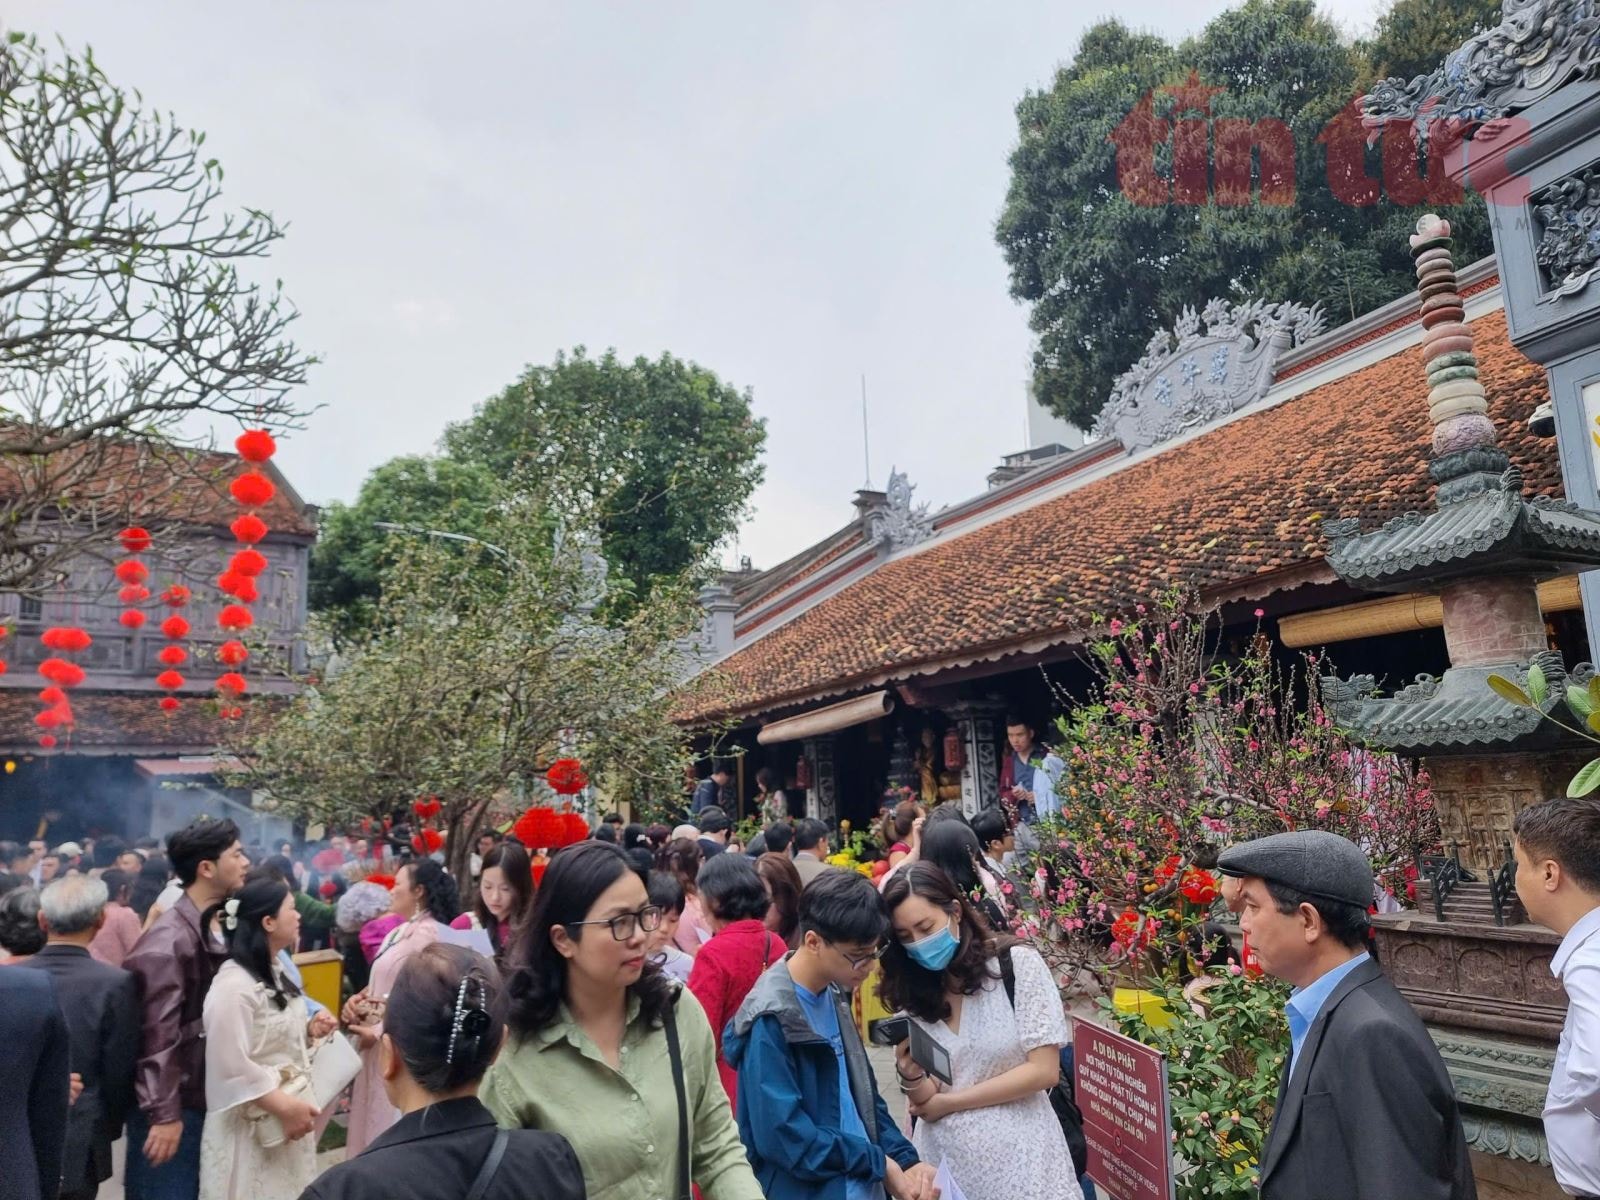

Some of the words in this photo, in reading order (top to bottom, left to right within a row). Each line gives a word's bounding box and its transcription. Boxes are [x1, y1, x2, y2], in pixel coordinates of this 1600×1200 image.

[1093, 1040, 1098, 1053] A
[1117, 1053, 1136, 1072] PHẬT
[1089, 1071, 1108, 1088] KHÁCH
[1133, 1094, 1150, 1112] HOAN
[1113, 1066, 1124, 1081] TÔN
[1124, 1073, 1147, 1094] NGHIÊM
[1080, 1078, 1098, 1097] KHÔNG
[1098, 1089, 1112, 1104] QUAY
[1127, 1106, 1144, 1125] CHỤP
